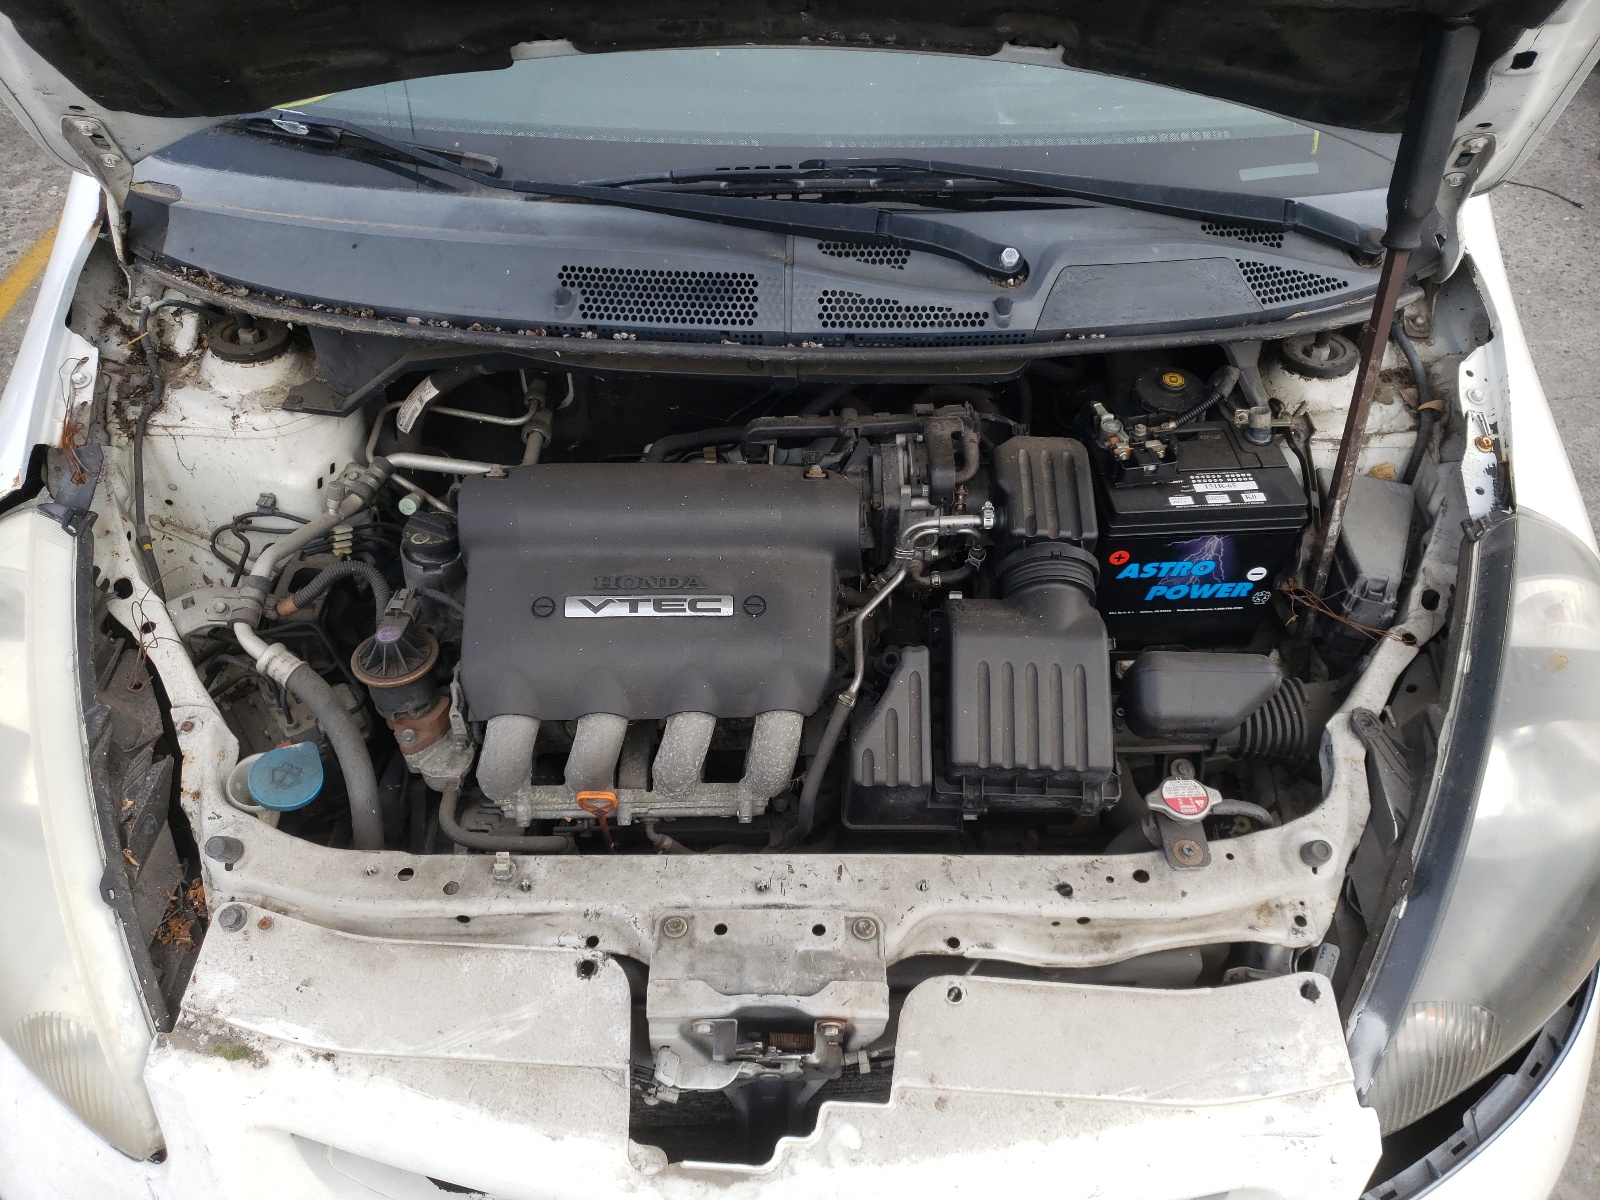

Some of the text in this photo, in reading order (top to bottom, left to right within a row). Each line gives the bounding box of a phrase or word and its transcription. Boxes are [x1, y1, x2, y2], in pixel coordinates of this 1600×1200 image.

[1115, 560, 1216, 579] ASTRO
[592, 575, 707, 590] HONDA
[1144, 582, 1254, 600] POWER
[578, 598, 722, 615] VTEC
